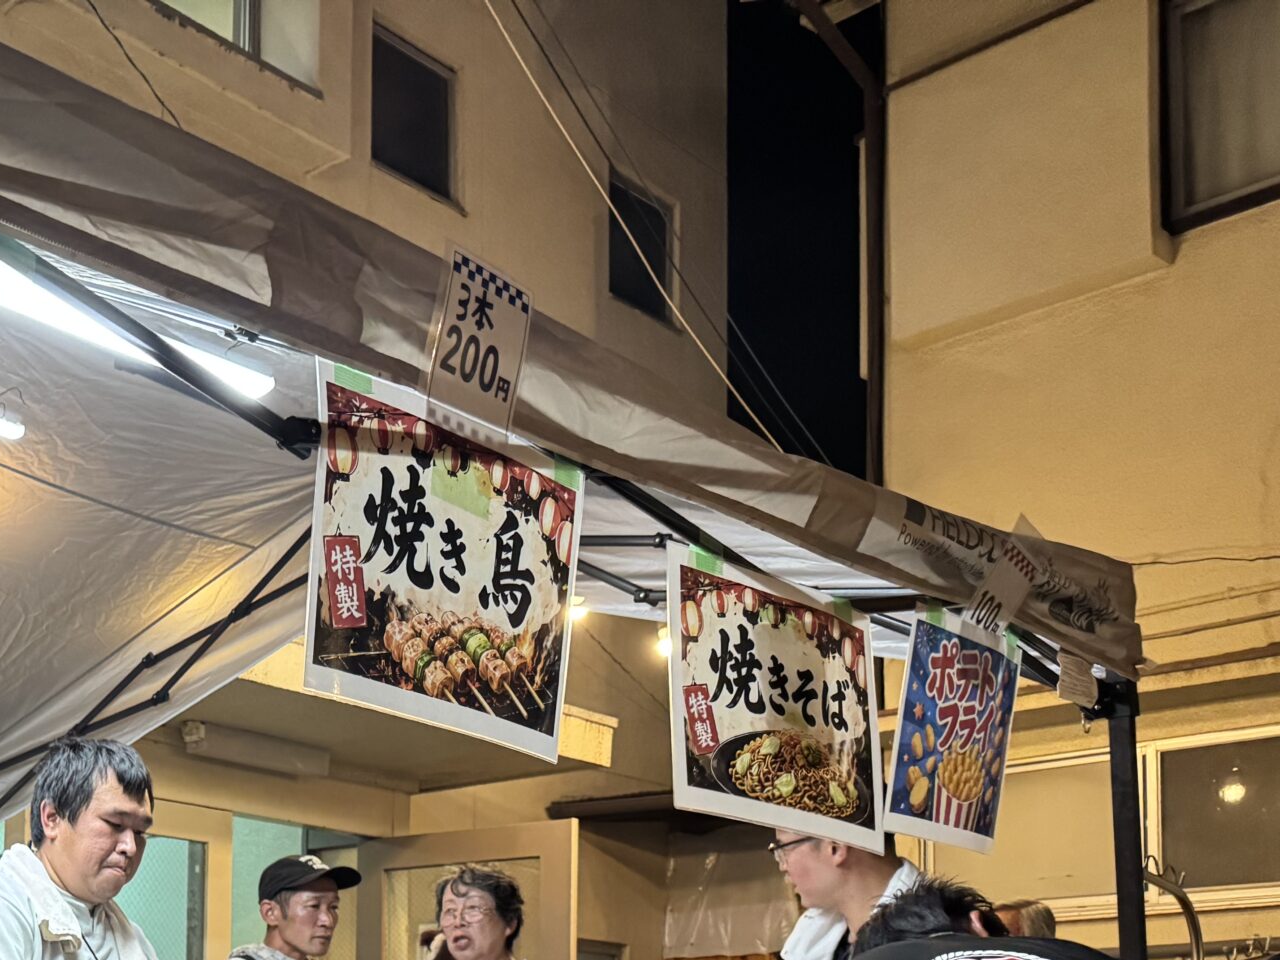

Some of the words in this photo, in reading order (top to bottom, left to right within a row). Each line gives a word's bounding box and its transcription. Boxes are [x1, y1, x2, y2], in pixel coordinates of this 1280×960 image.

[455, 282, 495, 332] 3本
[439, 323, 511, 403] 200円
[330, 544, 363, 620] 特製
[359, 463, 536, 629] 焼き鳥
[970, 589, 1000, 634] 100円
[708, 623, 851, 733] 焼きそば
[925, 638, 997, 710] ポテト
[688, 691, 716, 749] 特製
[936, 702, 996, 754] フライ
